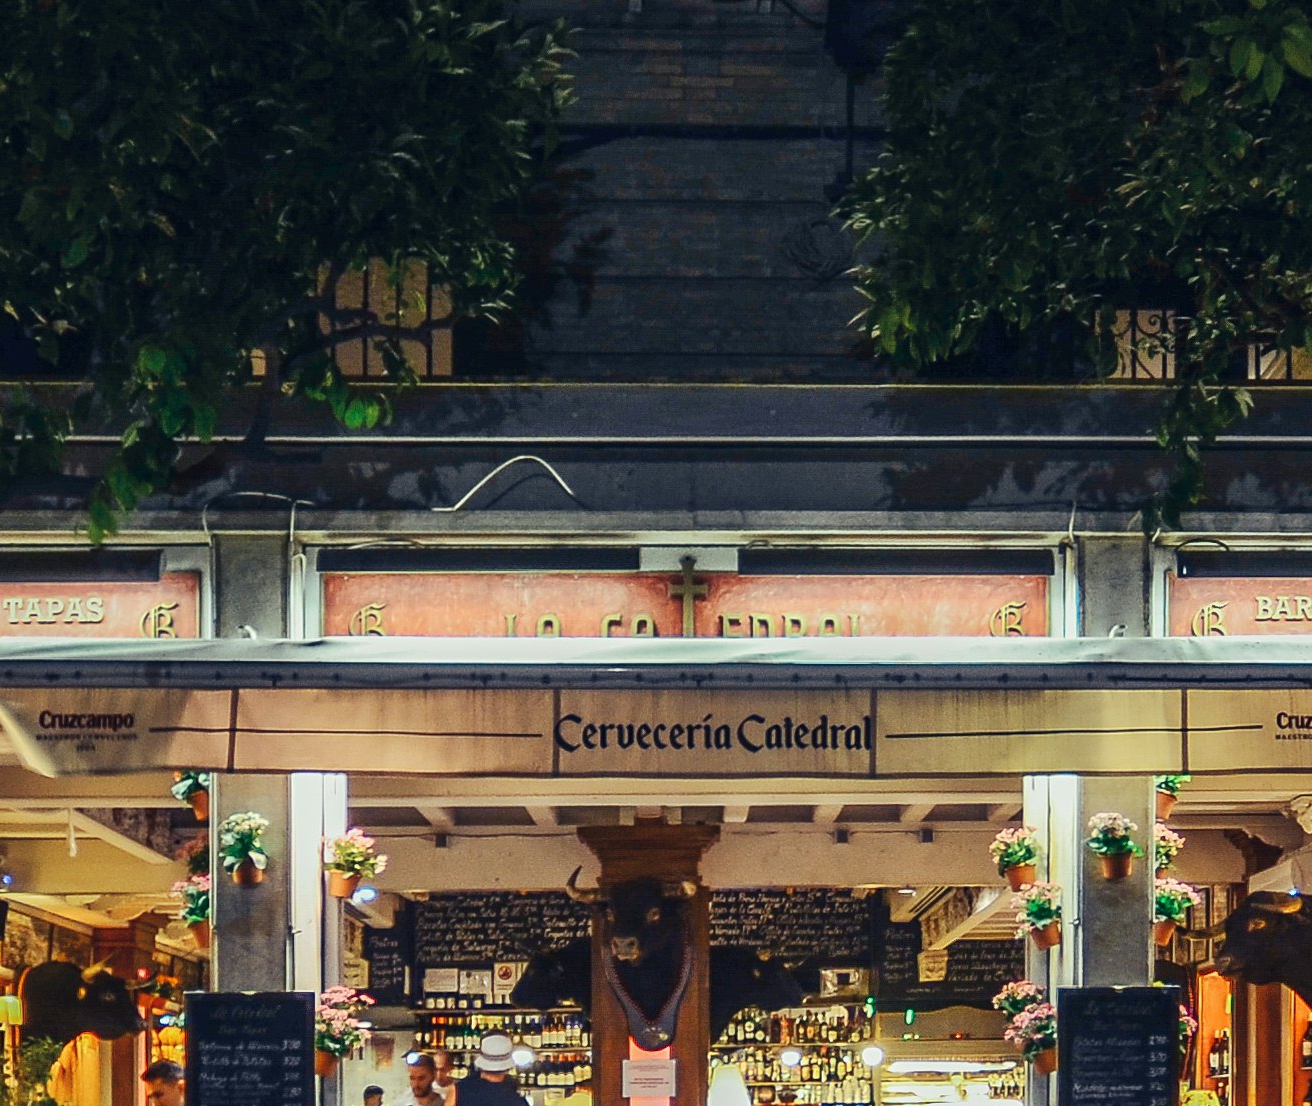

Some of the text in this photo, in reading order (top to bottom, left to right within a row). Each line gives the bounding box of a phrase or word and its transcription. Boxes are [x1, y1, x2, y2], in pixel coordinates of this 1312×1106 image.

[3, 596, 105, 624] TAPAS
[1255, 596, 1312, 622] BAR
[39, 710, 134, 731] Cruzcampo
[554, 714, 873, 752] Cervecería Catedral
